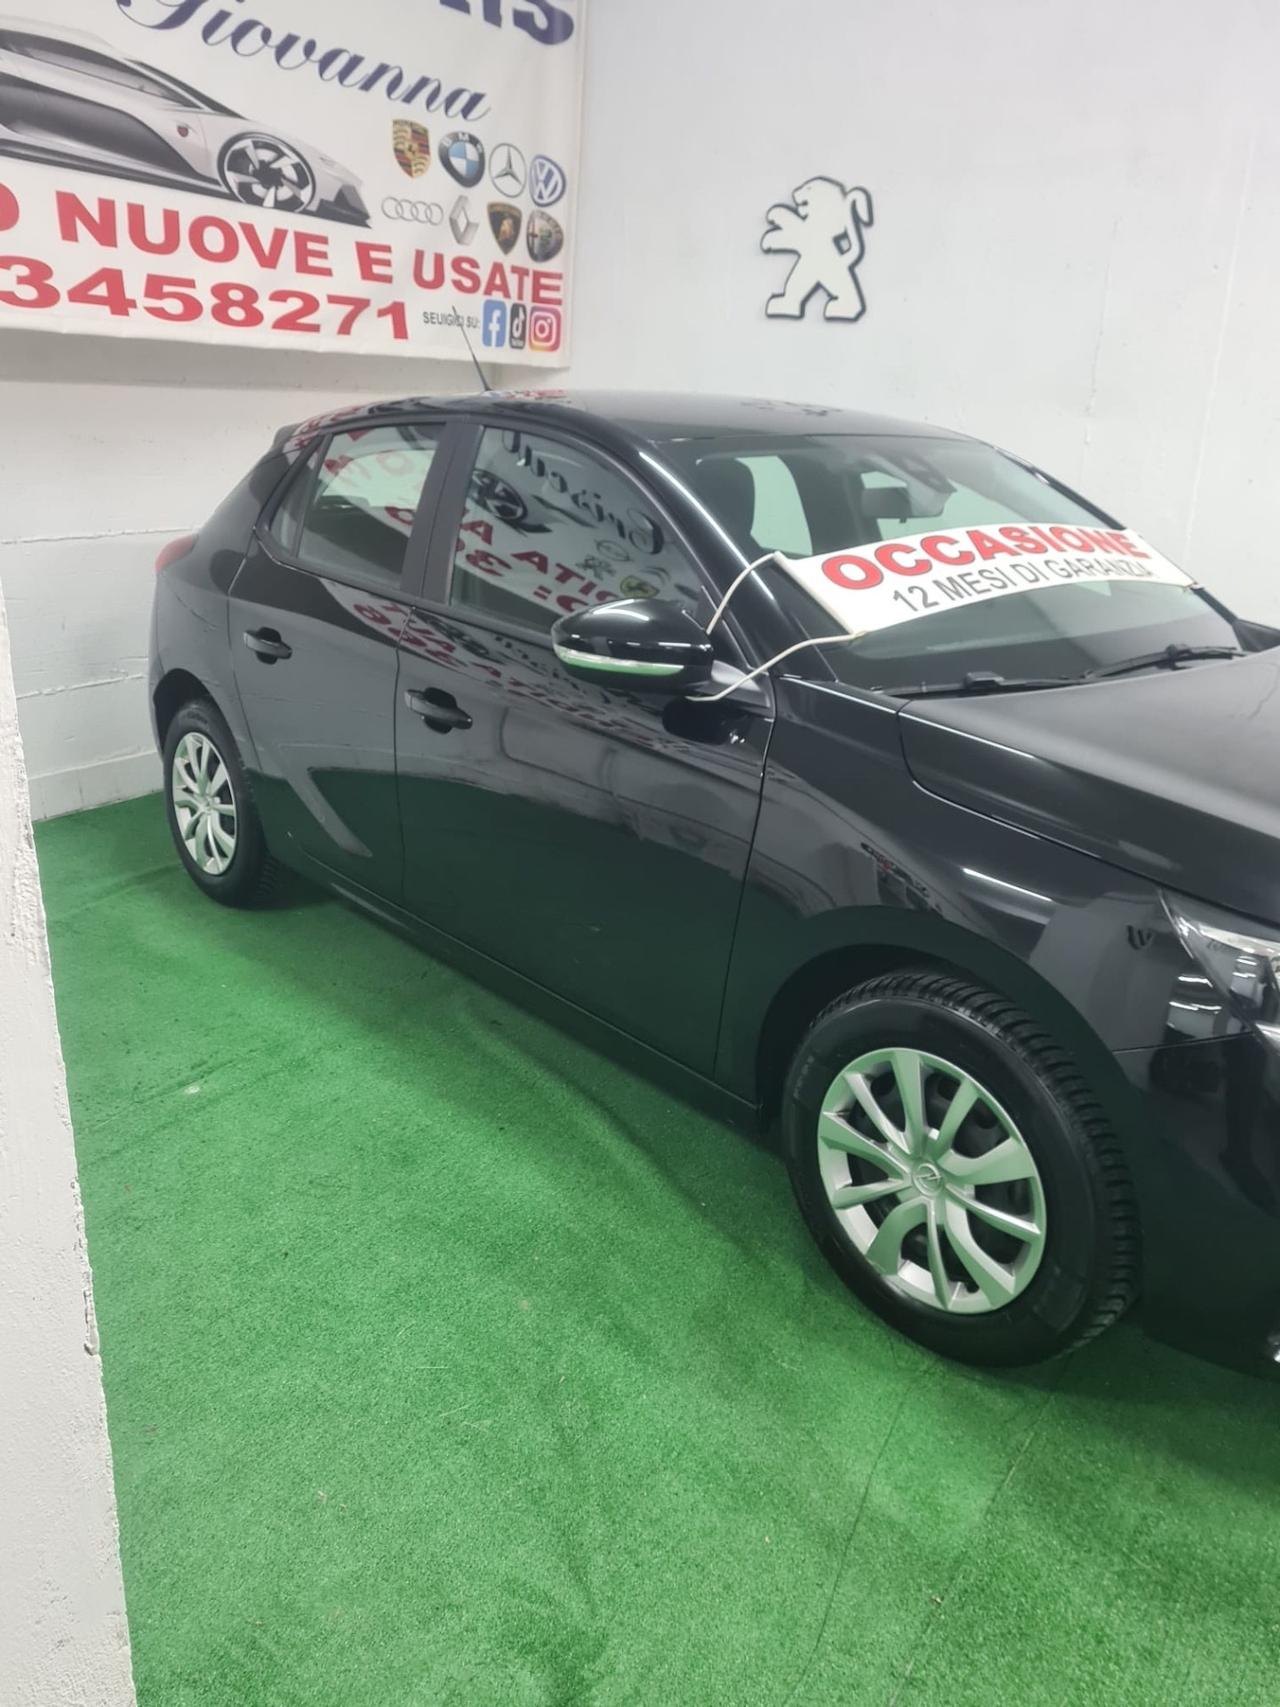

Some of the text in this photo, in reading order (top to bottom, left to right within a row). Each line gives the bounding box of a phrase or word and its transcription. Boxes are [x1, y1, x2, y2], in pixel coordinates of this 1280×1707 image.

[55, 190, 333, 279] NUOVE
[354, 240, 393, 285] E
[412, 250, 563, 306] USATE
[0, 255, 409, 342] 3458271
[821, 526, 1152, 590] OCCASIONE
[893, 558, 1155, 612] 12 MESI DI GARANZIA
